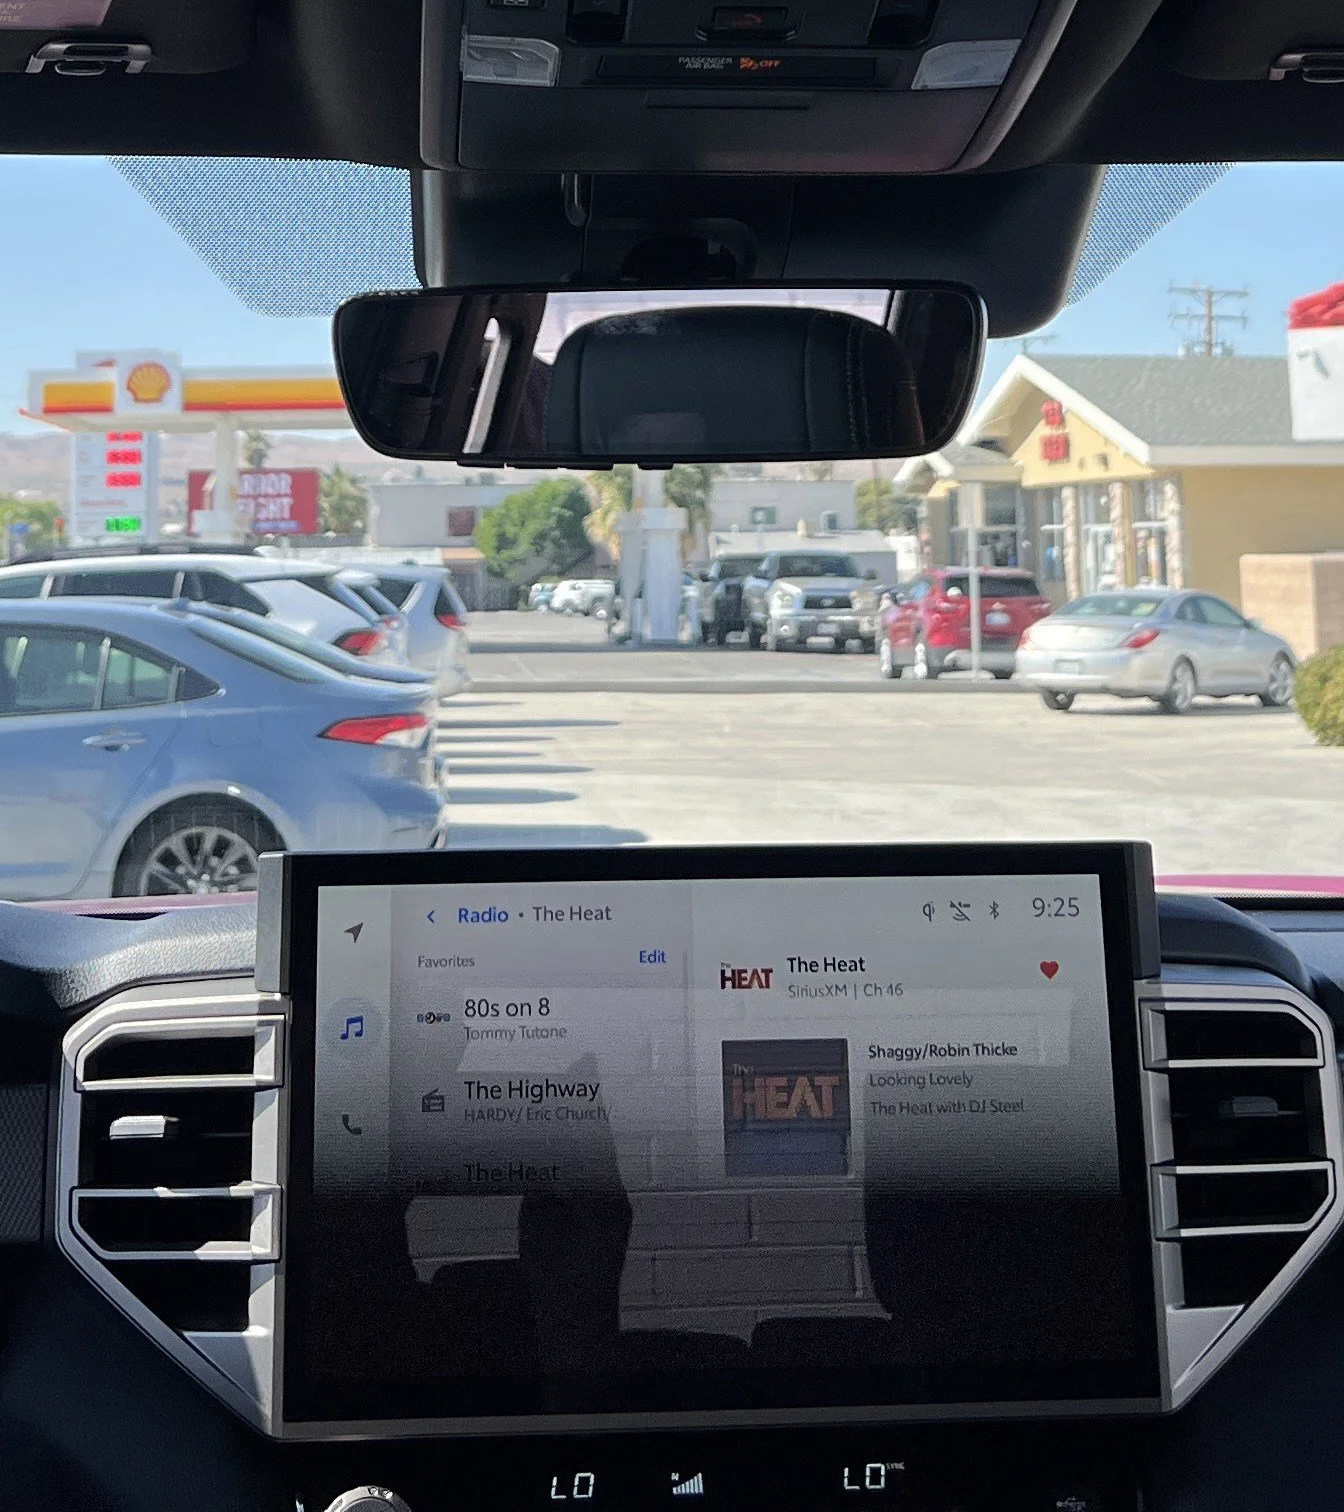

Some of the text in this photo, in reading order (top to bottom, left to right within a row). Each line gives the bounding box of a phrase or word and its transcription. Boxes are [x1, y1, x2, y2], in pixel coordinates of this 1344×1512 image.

[458, 906, 613, 923] Radio The Heat
[1032, 897, 1081, 917] 9:25
[417, 954, 476, 969] Favorites
[639, 949, 667, 964] Edit
[787, 956, 866, 973] The Heat
[720, 968, 774, 990] HEAT
[788, 983, 905, 999] SiriusXM Ch 46
[464, 998, 500, 1018] 80s
[505, 1002, 532, 1017] on
[538, 997, 551, 1017] 8
[464, 1025, 569, 1043] Tommy Tutone
[868, 1042, 1018, 1061] Shaggy/Robin Thicke
[868, 1072, 974, 1089] Looking Lovely
[464, 1079, 600, 1104] The Highway
[732, 1075, 840, 1119] HEAT
[526, 1106, 552, 1122] Eric
[870, 1101, 896, 1116] The
[899, 1101, 934, 1116] Heat
[936, 1100, 966, 1115] with
[464, 1162, 560, 1183] The Heat
[843, 1463, 886, 1490] LO
[551, 1472, 596, 1500] LO
